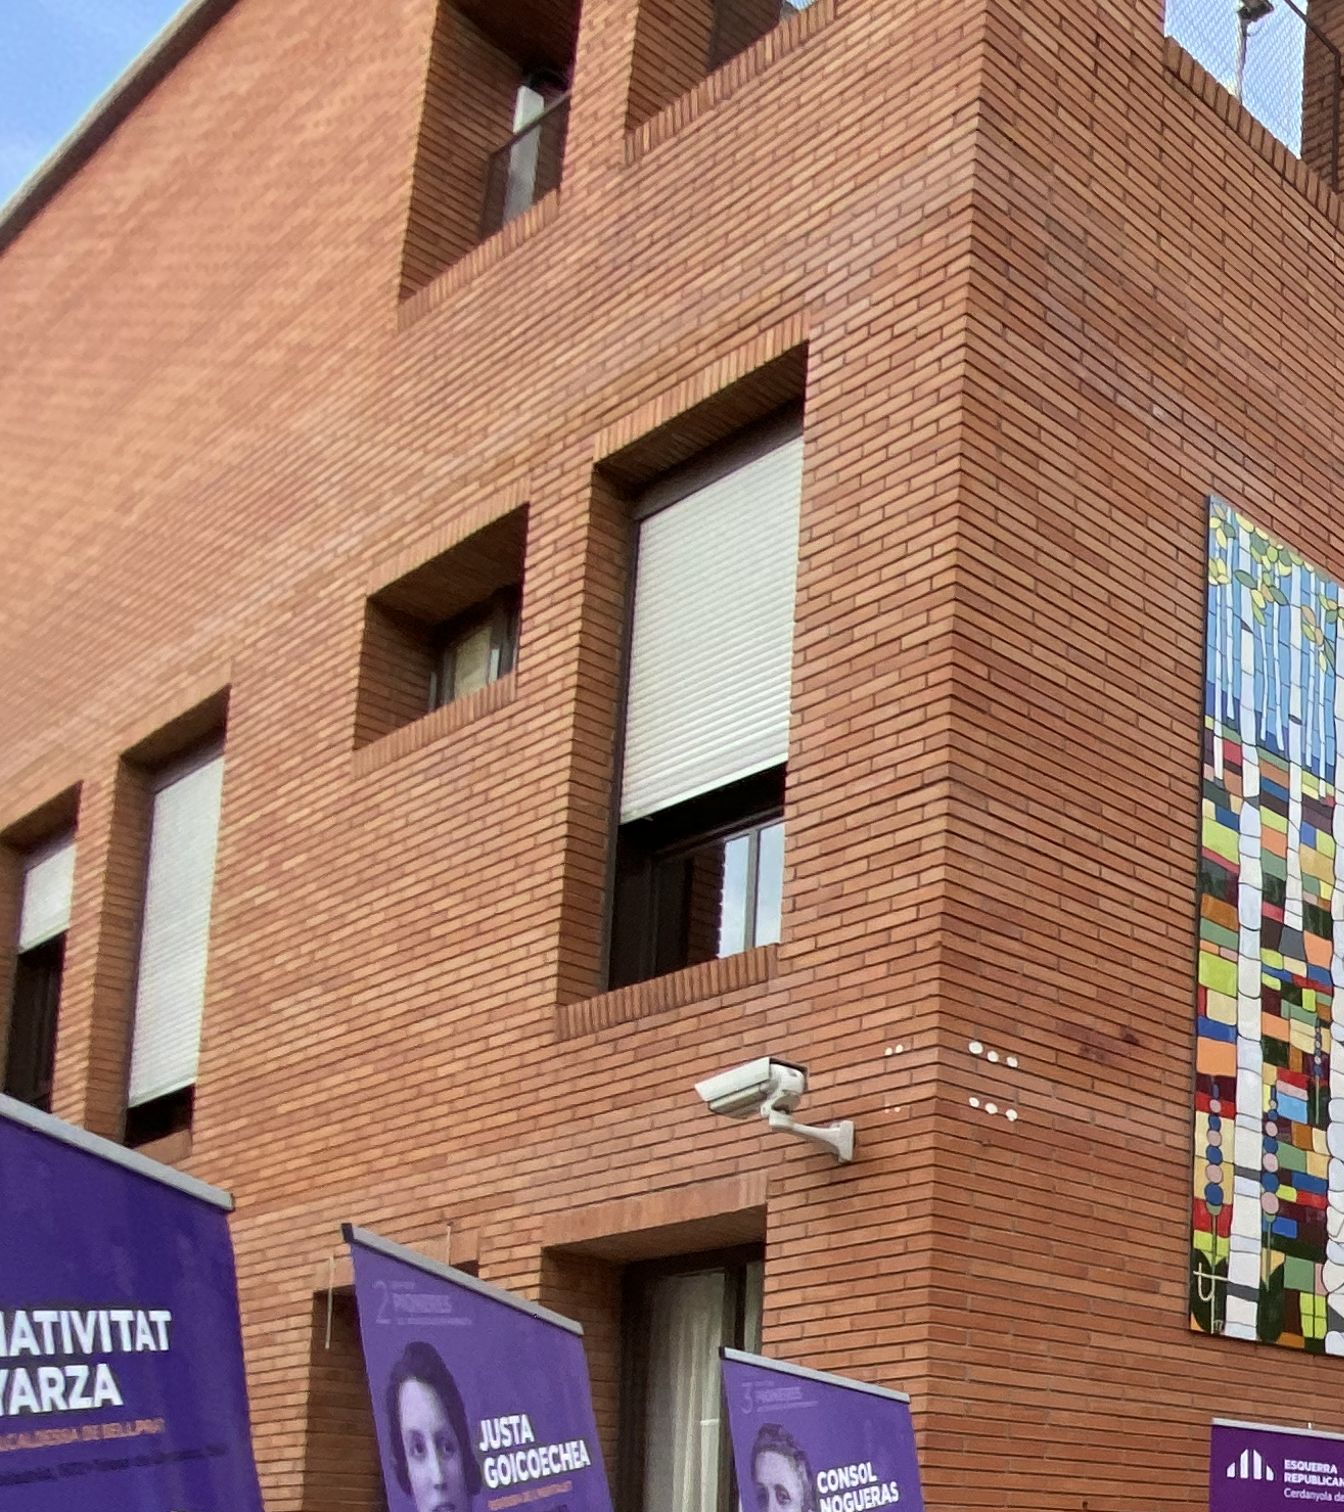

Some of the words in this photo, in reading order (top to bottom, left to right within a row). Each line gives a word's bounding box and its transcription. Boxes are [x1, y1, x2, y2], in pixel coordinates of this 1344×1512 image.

[480, 1414, 534, 1451] JUSTA
[484, 1440, 591, 1488] GOICOECHEA
[817, 1462, 877, 1494] CONSOL
[1284, 1459, 1338, 1474] ESQUERRA
